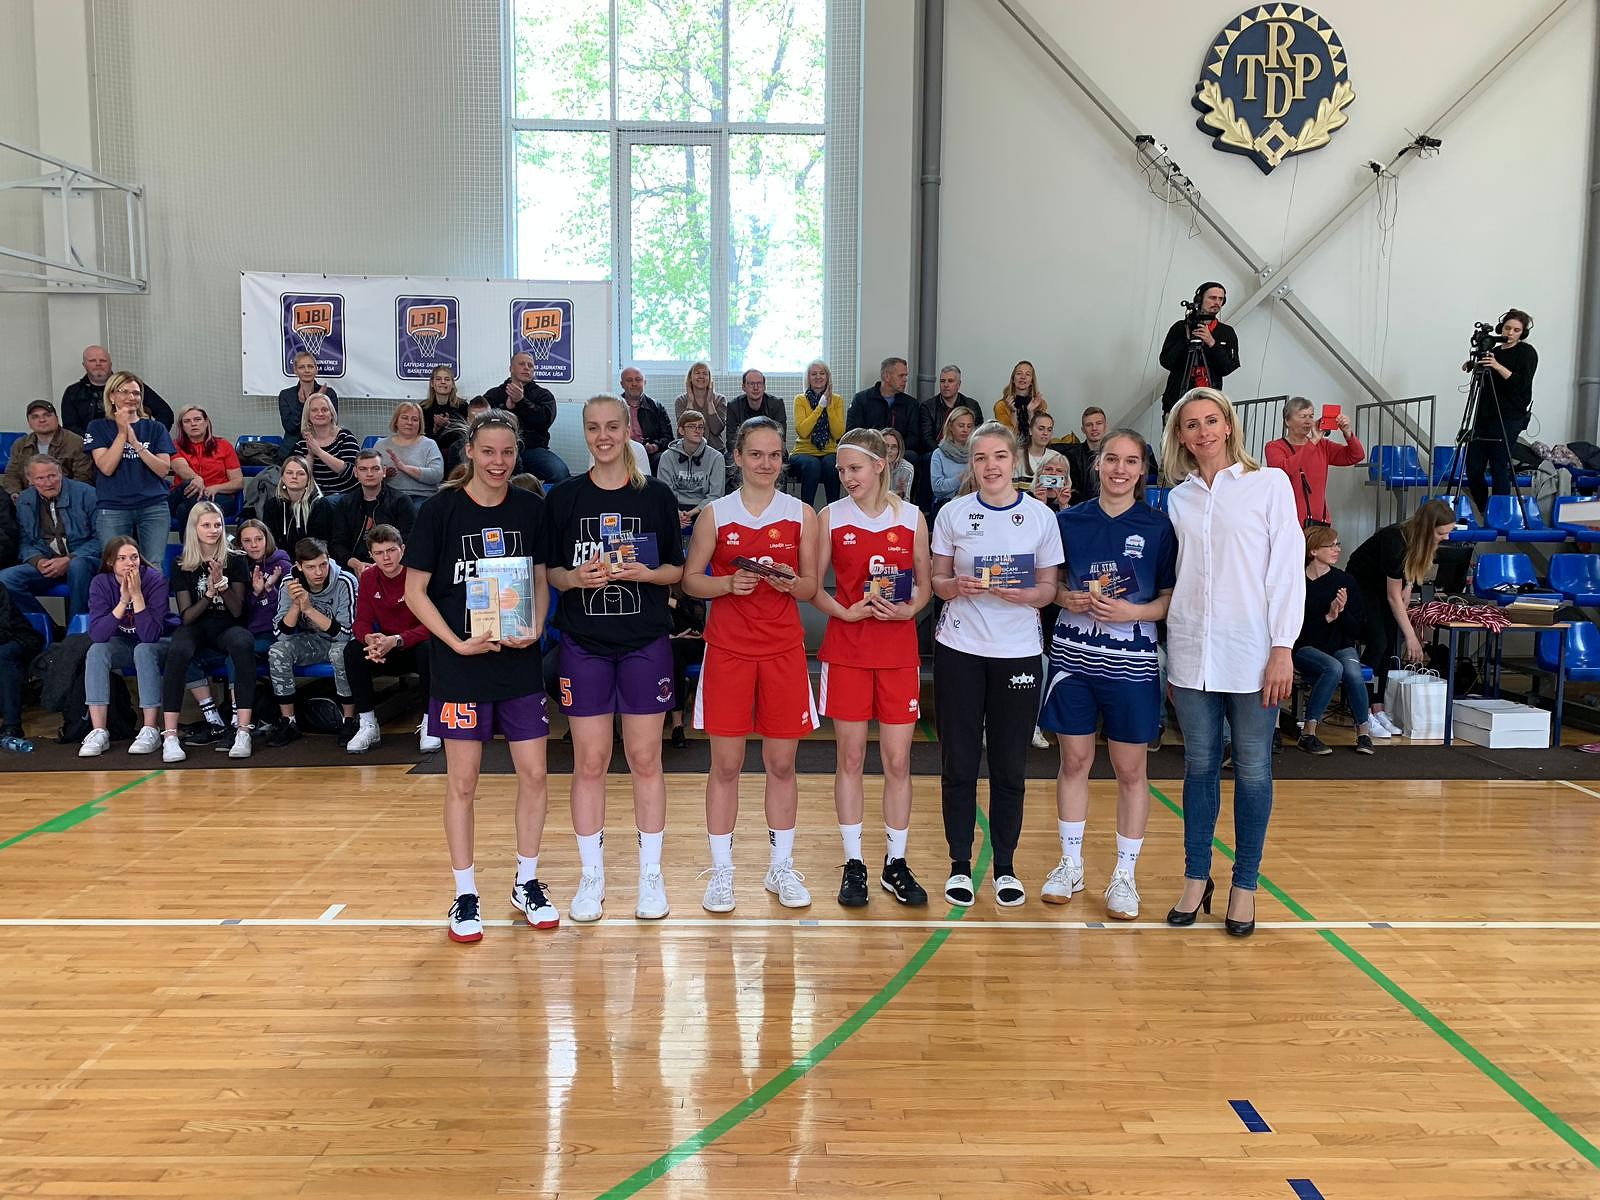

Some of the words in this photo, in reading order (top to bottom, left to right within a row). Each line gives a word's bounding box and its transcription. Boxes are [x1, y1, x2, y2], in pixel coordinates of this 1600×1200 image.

[297, 309, 329, 324] LJBL
[411, 311, 444, 327] LJBL
[526, 314, 558, 330] LJBL
[1089, 564, 1100, 574] ALL
[1101, 562, 1118, 573] STAR
[440, 702, 478, 730] 45
